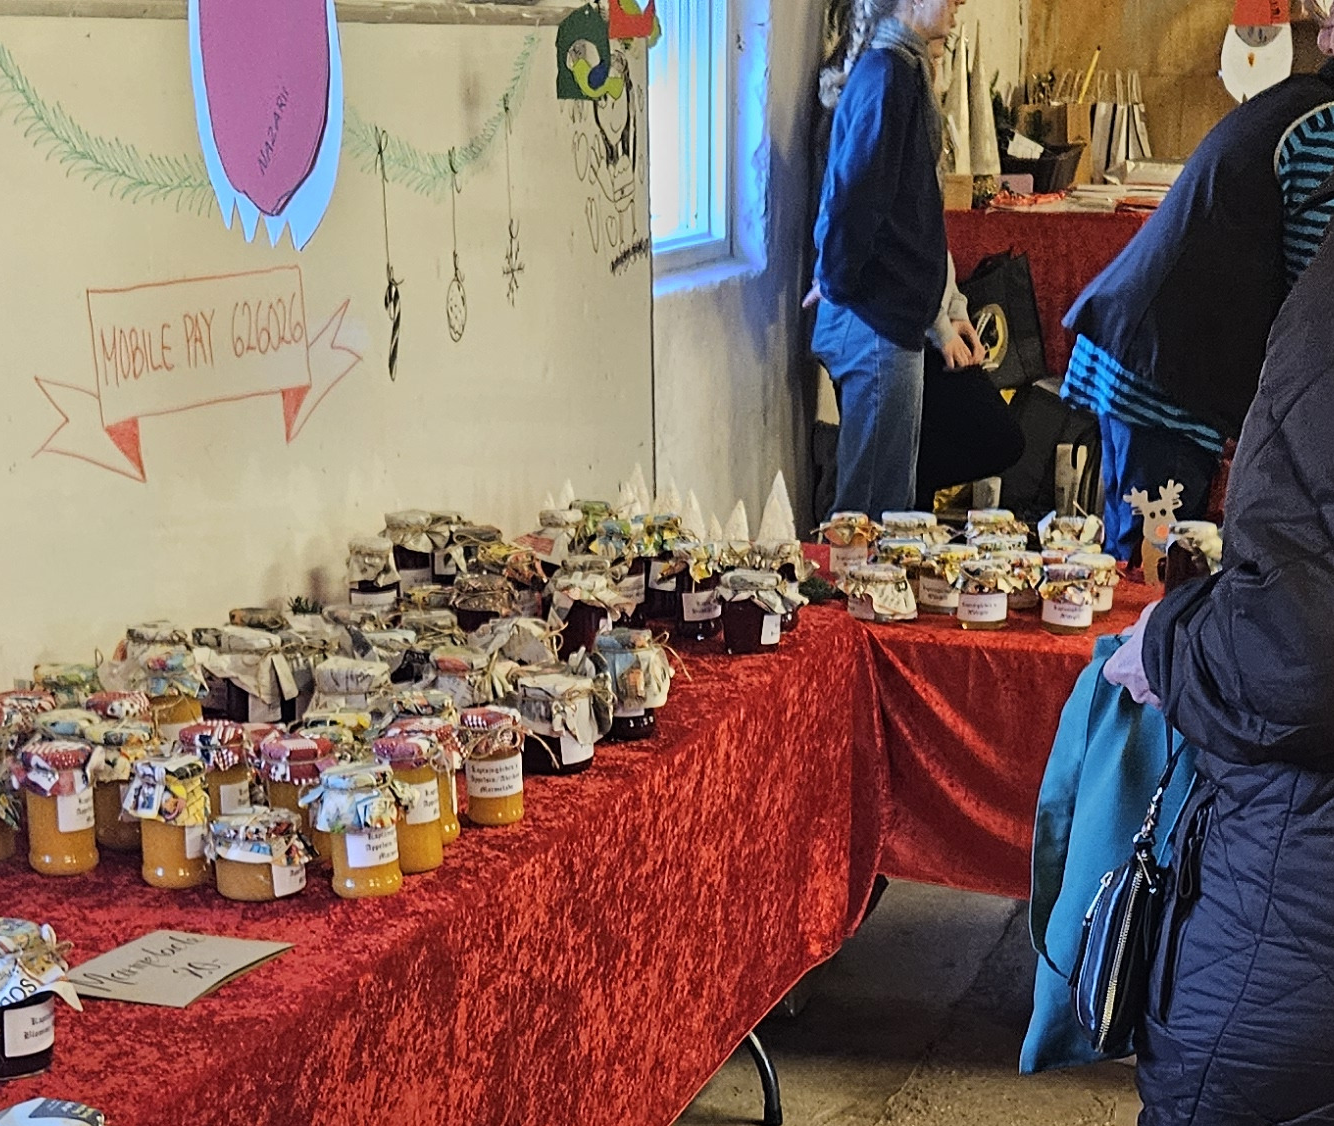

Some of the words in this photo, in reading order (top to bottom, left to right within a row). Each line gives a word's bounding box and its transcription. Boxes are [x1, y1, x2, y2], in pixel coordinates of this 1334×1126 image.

[100, 323, 174, 388] MOBILE
[183, 308, 215, 369] PAY
[231, 292, 304, 358] 626026
